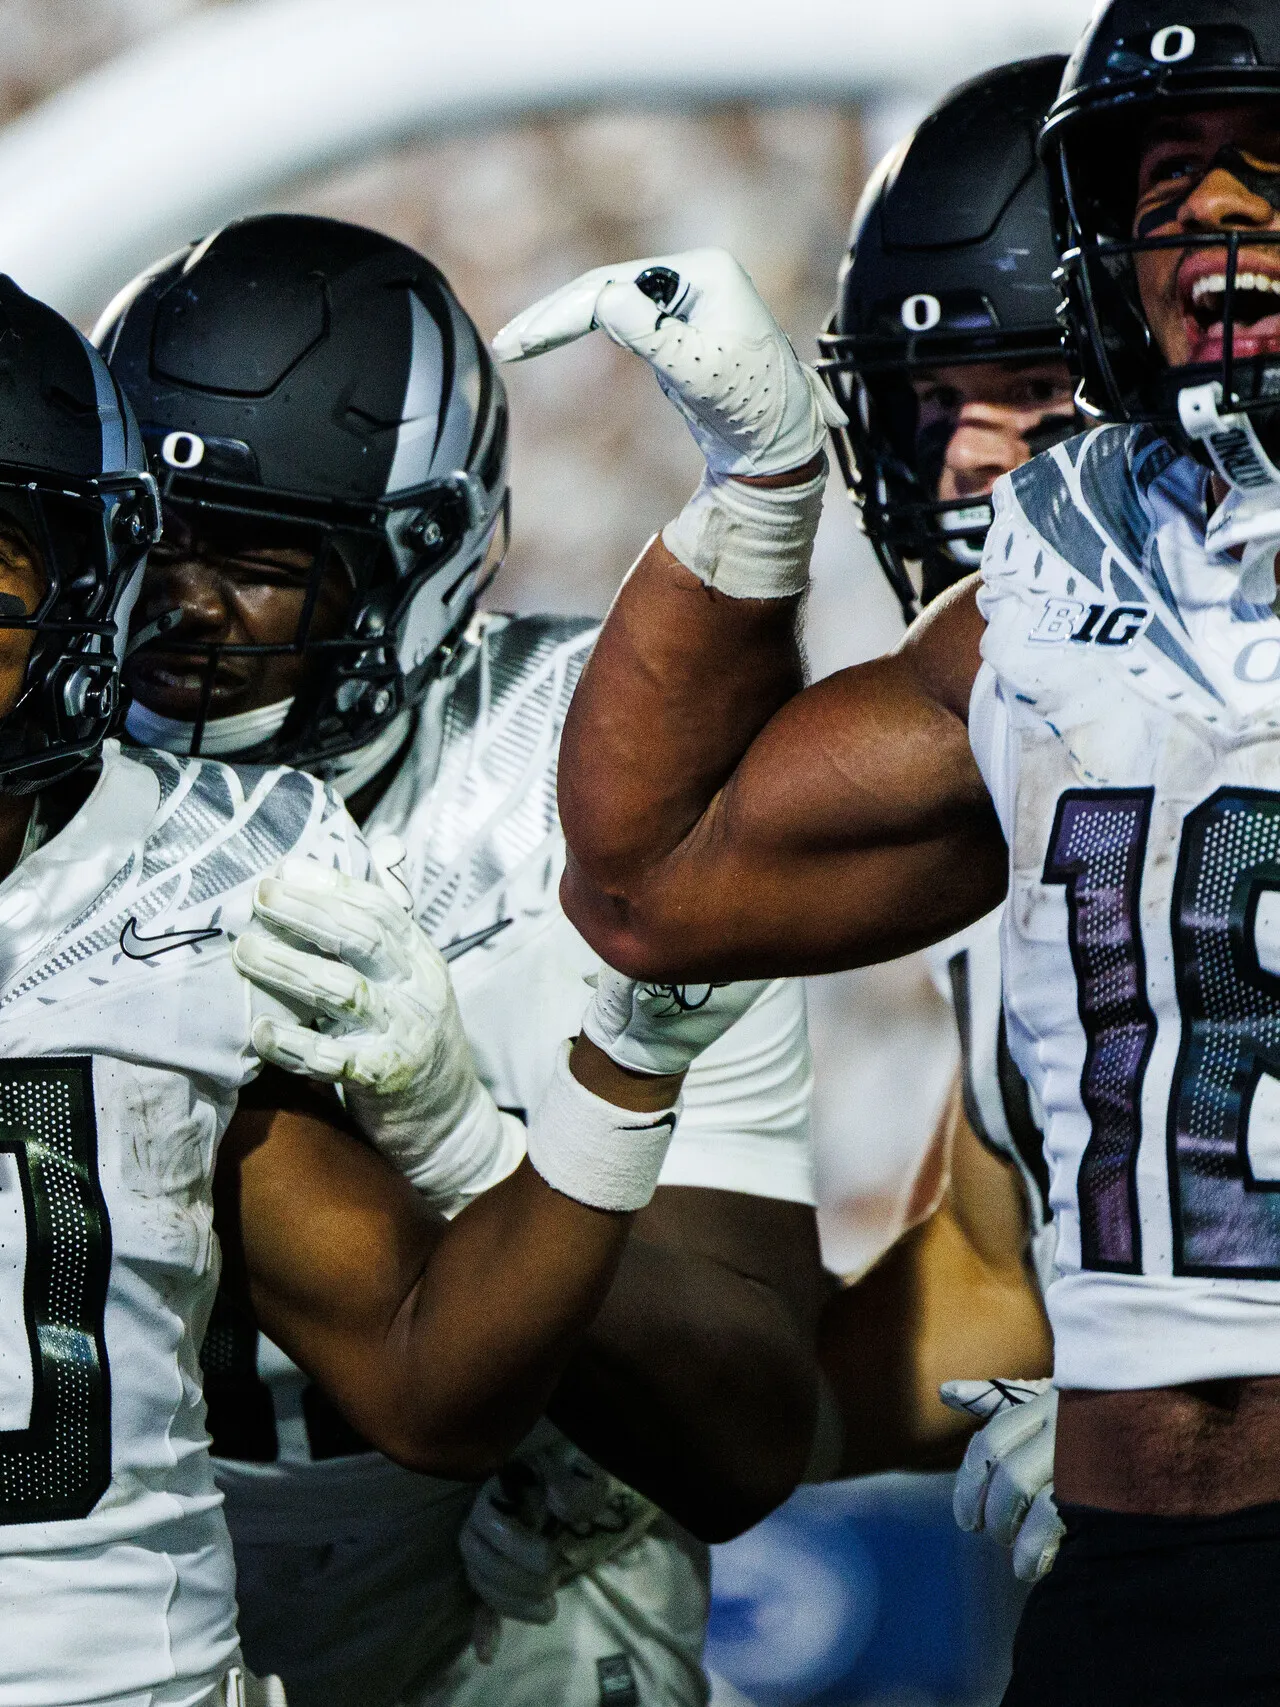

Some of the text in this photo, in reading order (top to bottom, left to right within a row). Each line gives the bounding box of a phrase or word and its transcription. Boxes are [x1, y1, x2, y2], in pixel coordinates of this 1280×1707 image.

[1150, 25, 1195, 63] O
[901, 294, 941, 331] O
[162, 431, 204, 469] O
